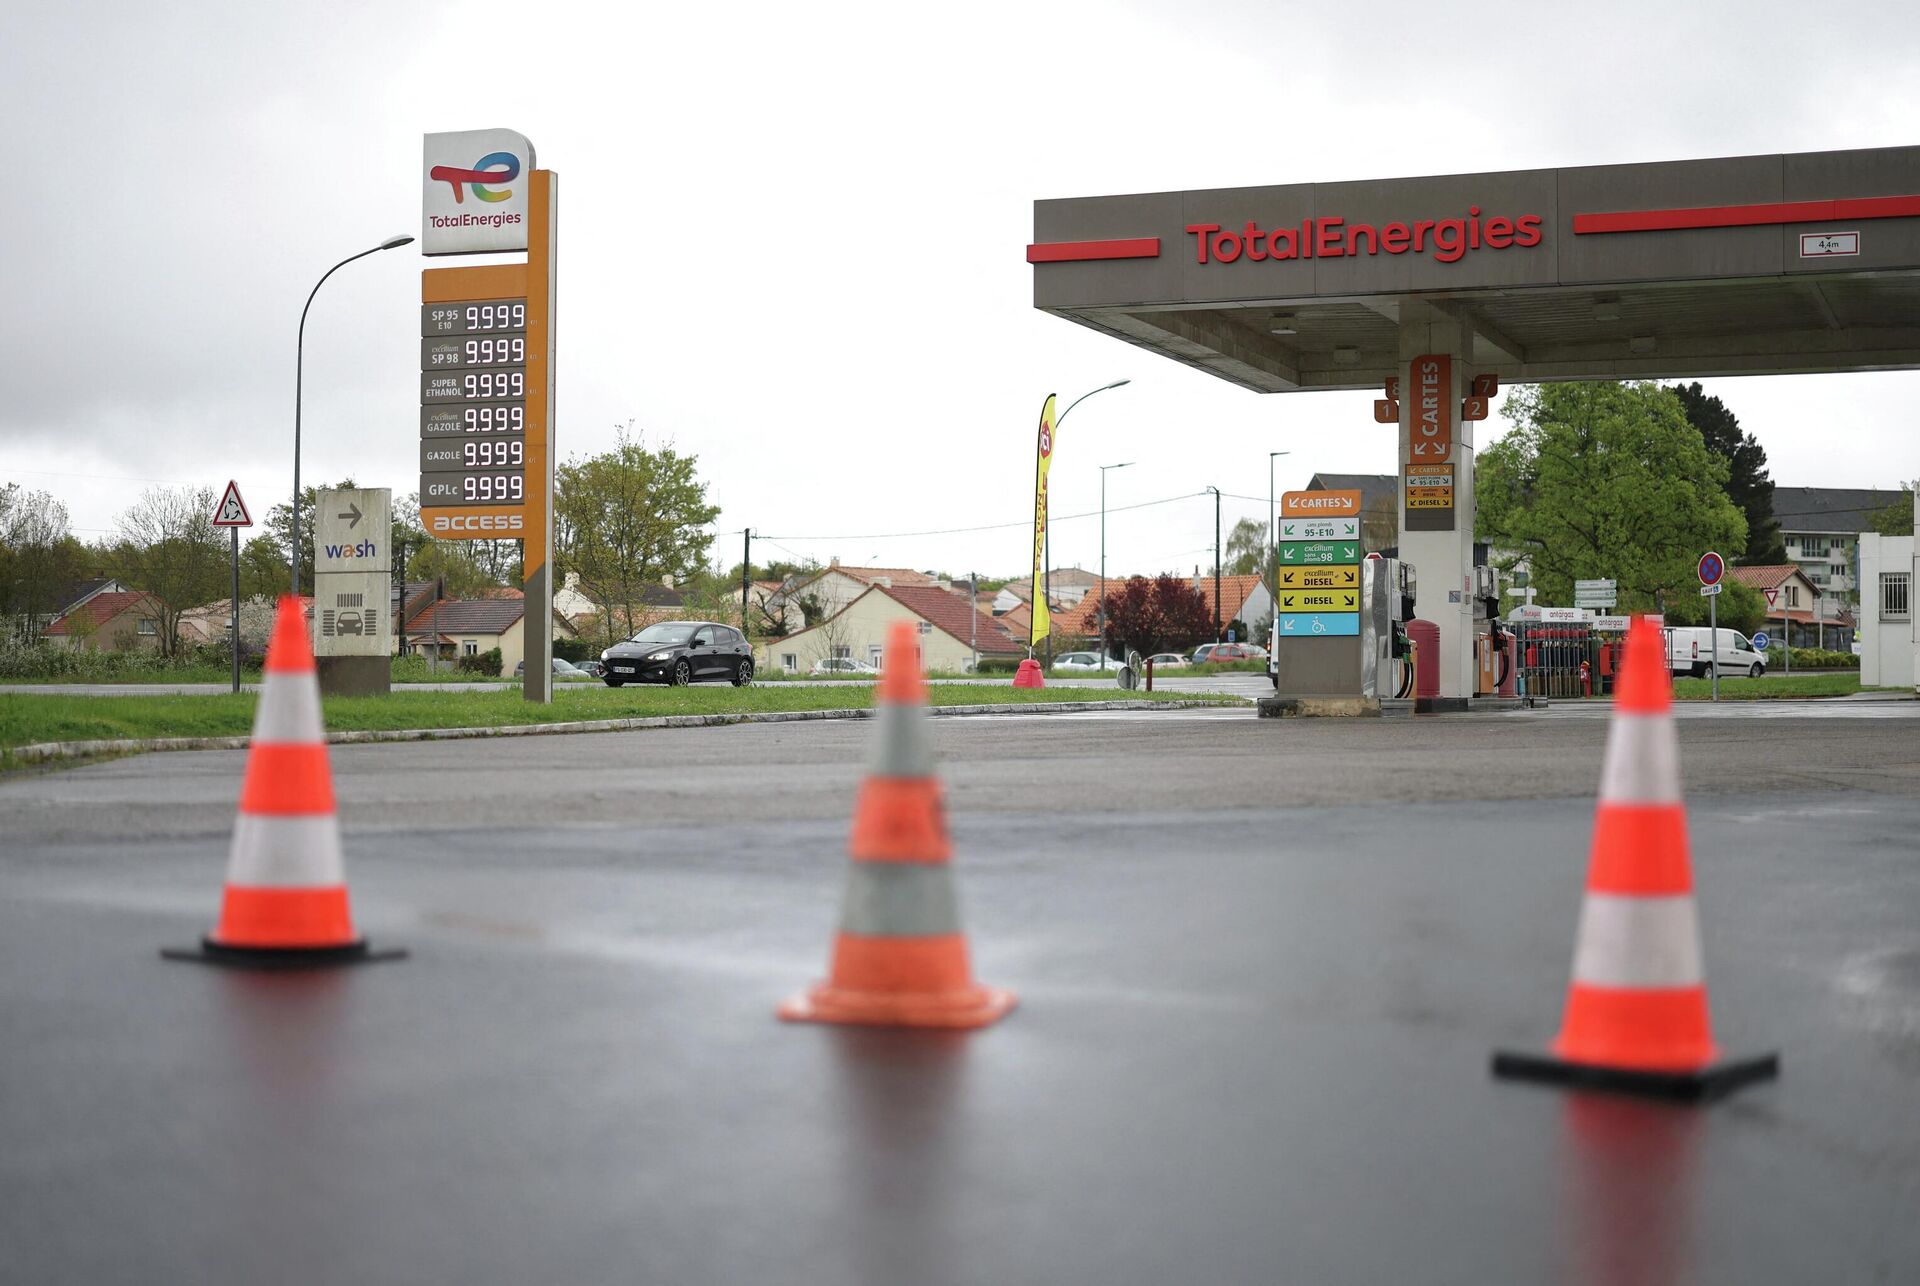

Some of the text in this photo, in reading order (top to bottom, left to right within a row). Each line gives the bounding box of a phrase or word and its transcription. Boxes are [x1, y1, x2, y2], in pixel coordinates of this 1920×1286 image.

[430, 212, 521, 228] TotalEnergies
[1185, 205, 1542, 264] TotalEnergies
[432, 311, 444, 321] SP
[446, 310, 458, 320] 95
[466, 304, 525, 330] 9.999
[438, 321, 452, 330] E10
[432, 354, 444, 364] SP
[446, 353, 459, 364] 98
[465, 338, 524, 363] 9.999
[425, 387, 462, 397] ETHANOL
[431, 372, 523, 398] SUPER 9.999
[1481, 379, 1490, 393] 7
[1422, 361, 1438, 437] CARTES
[1382, 404, 1389, 417] 1
[1471, 401, 1481, 416] 2
[427, 406, 523, 432] GAZOLE 9.999
[426, 451, 461, 460] GAZOLE
[464, 441, 523, 466] 9.999
[428, 475, 523, 500] GPLc 9.999
[1300, 497, 1340, 508] CARTES
[1304, 528, 1335, 537] 95-E10
[325, 538, 376, 559] wash
[1320, 552, 1333, 562] 98
[1304, 578, 1334, 586] DIESEL
[1304, 597, 1334, 605] DIESEL
[1549, 610, 1575, 620] antargaz
